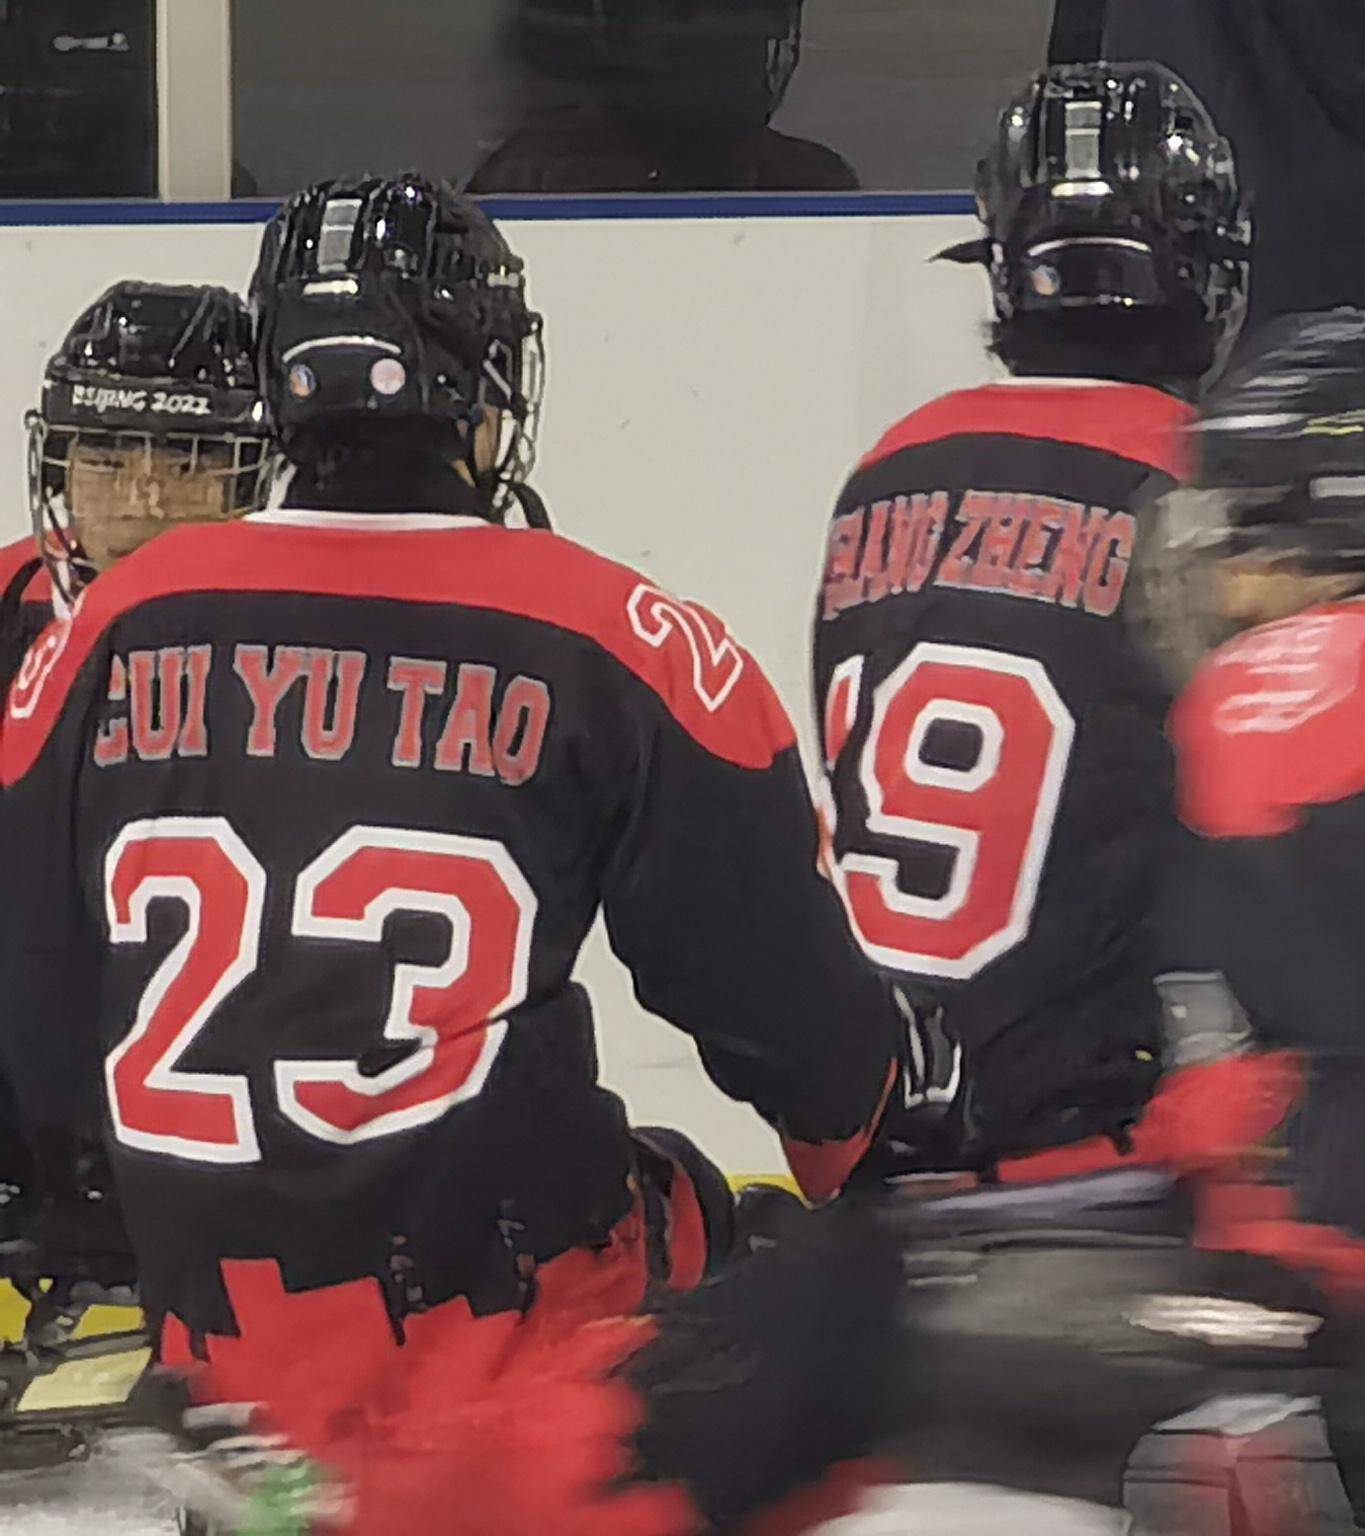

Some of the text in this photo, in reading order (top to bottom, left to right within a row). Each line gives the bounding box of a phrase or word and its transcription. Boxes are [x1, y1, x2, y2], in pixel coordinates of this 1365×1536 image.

[932, 489, 1137, 617] ZHENG
[233, 643, 367, 761] YU
[387, 656, 551, 787] TAO
[104, 816, 540, 1164] 23
